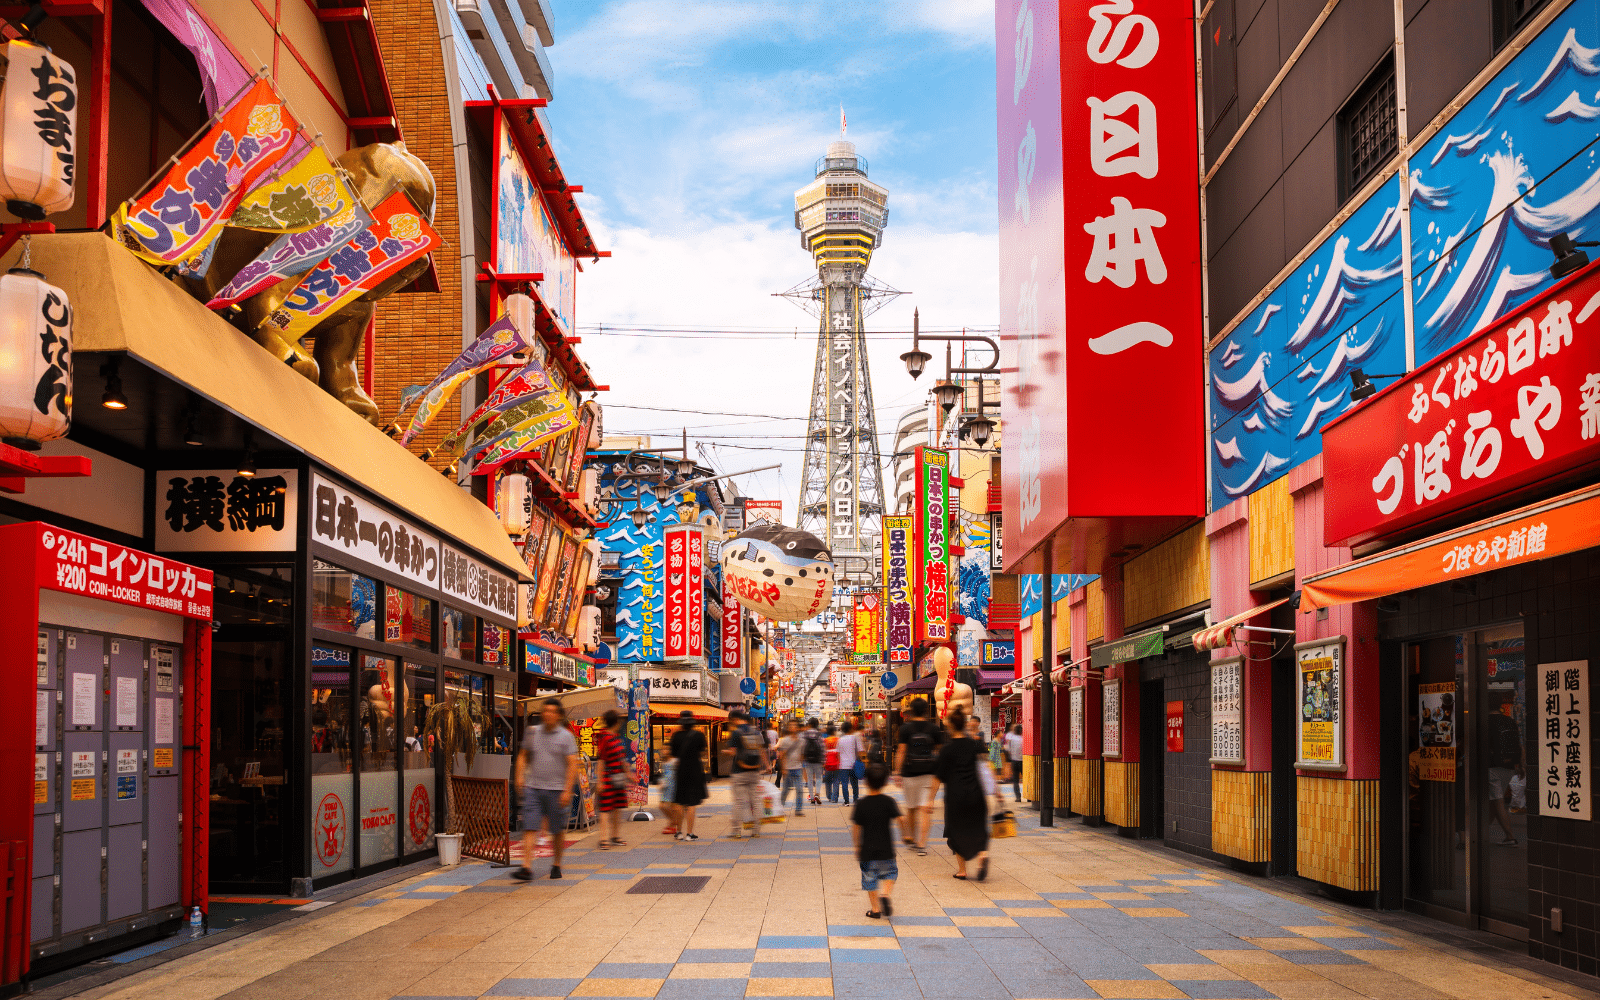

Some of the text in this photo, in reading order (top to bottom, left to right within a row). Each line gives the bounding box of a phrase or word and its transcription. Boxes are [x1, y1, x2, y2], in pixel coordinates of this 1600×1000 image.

[832, 312, 854, 539] 社会イノベーションの日立
[166, 475, 288, 533] 横綱
[57, 534, 87, 565] 24h
[315, 484, 438, 582] 日本一の串かつ
[670, 537, 684, 568] 名物
[1443, 522, 1548, 573] づぼらや新館
[57, 562, 86, 592] ¥200
[89, 580, 141, 603] COIN-LOCKER
[90, 542, 212, 598] コインロッカー
[928, 624, 946, 638] 酒処
[1545, 669, 1561, 810] 御利用下さい
[1564, 668, 1581, 813] 階上お座敷を
